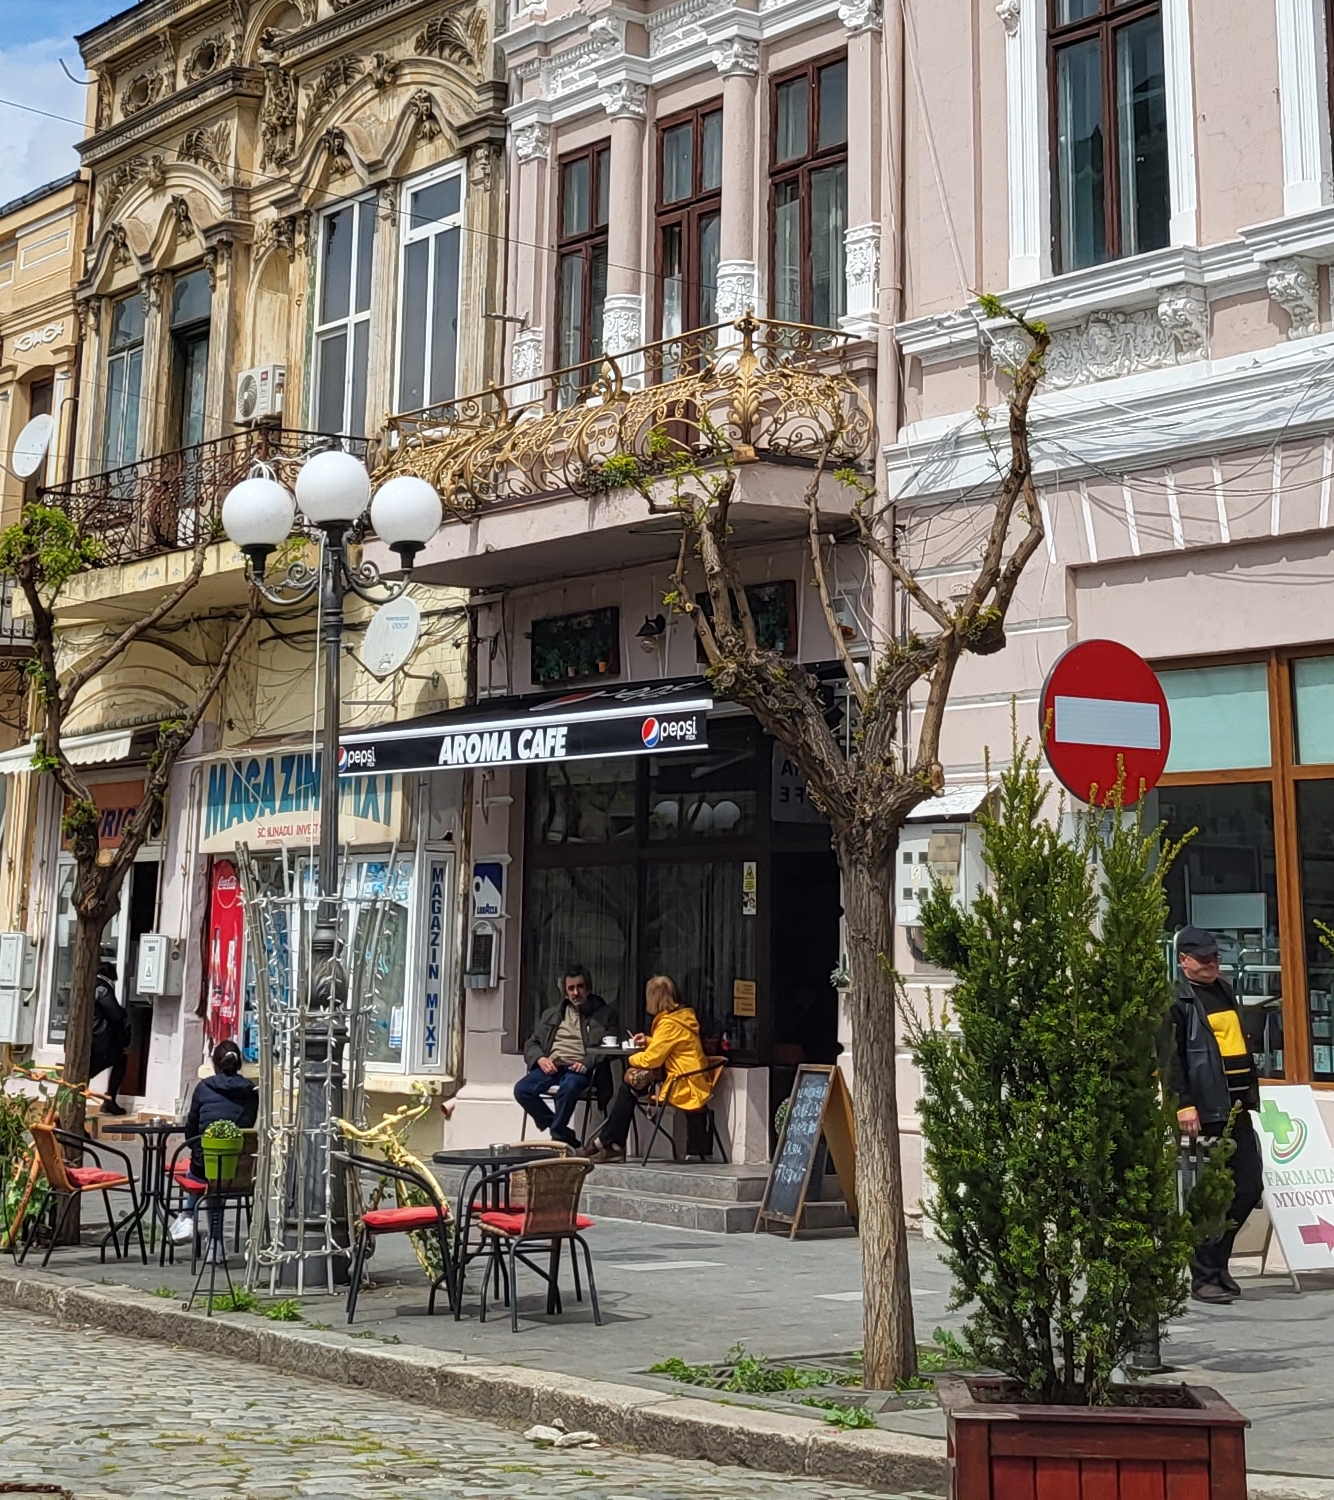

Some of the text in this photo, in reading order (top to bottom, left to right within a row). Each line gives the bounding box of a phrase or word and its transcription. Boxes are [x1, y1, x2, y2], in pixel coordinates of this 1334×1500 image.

[438, 726, 568, 765] AROMA CAFE
[660, 716, 697, 741] pepsi
[348, 746, 376, 768] pepsi
[204, 752, 323, 841] MAGAZIN
[426, 868, 443, 1057] MAGAZIN MIXT
